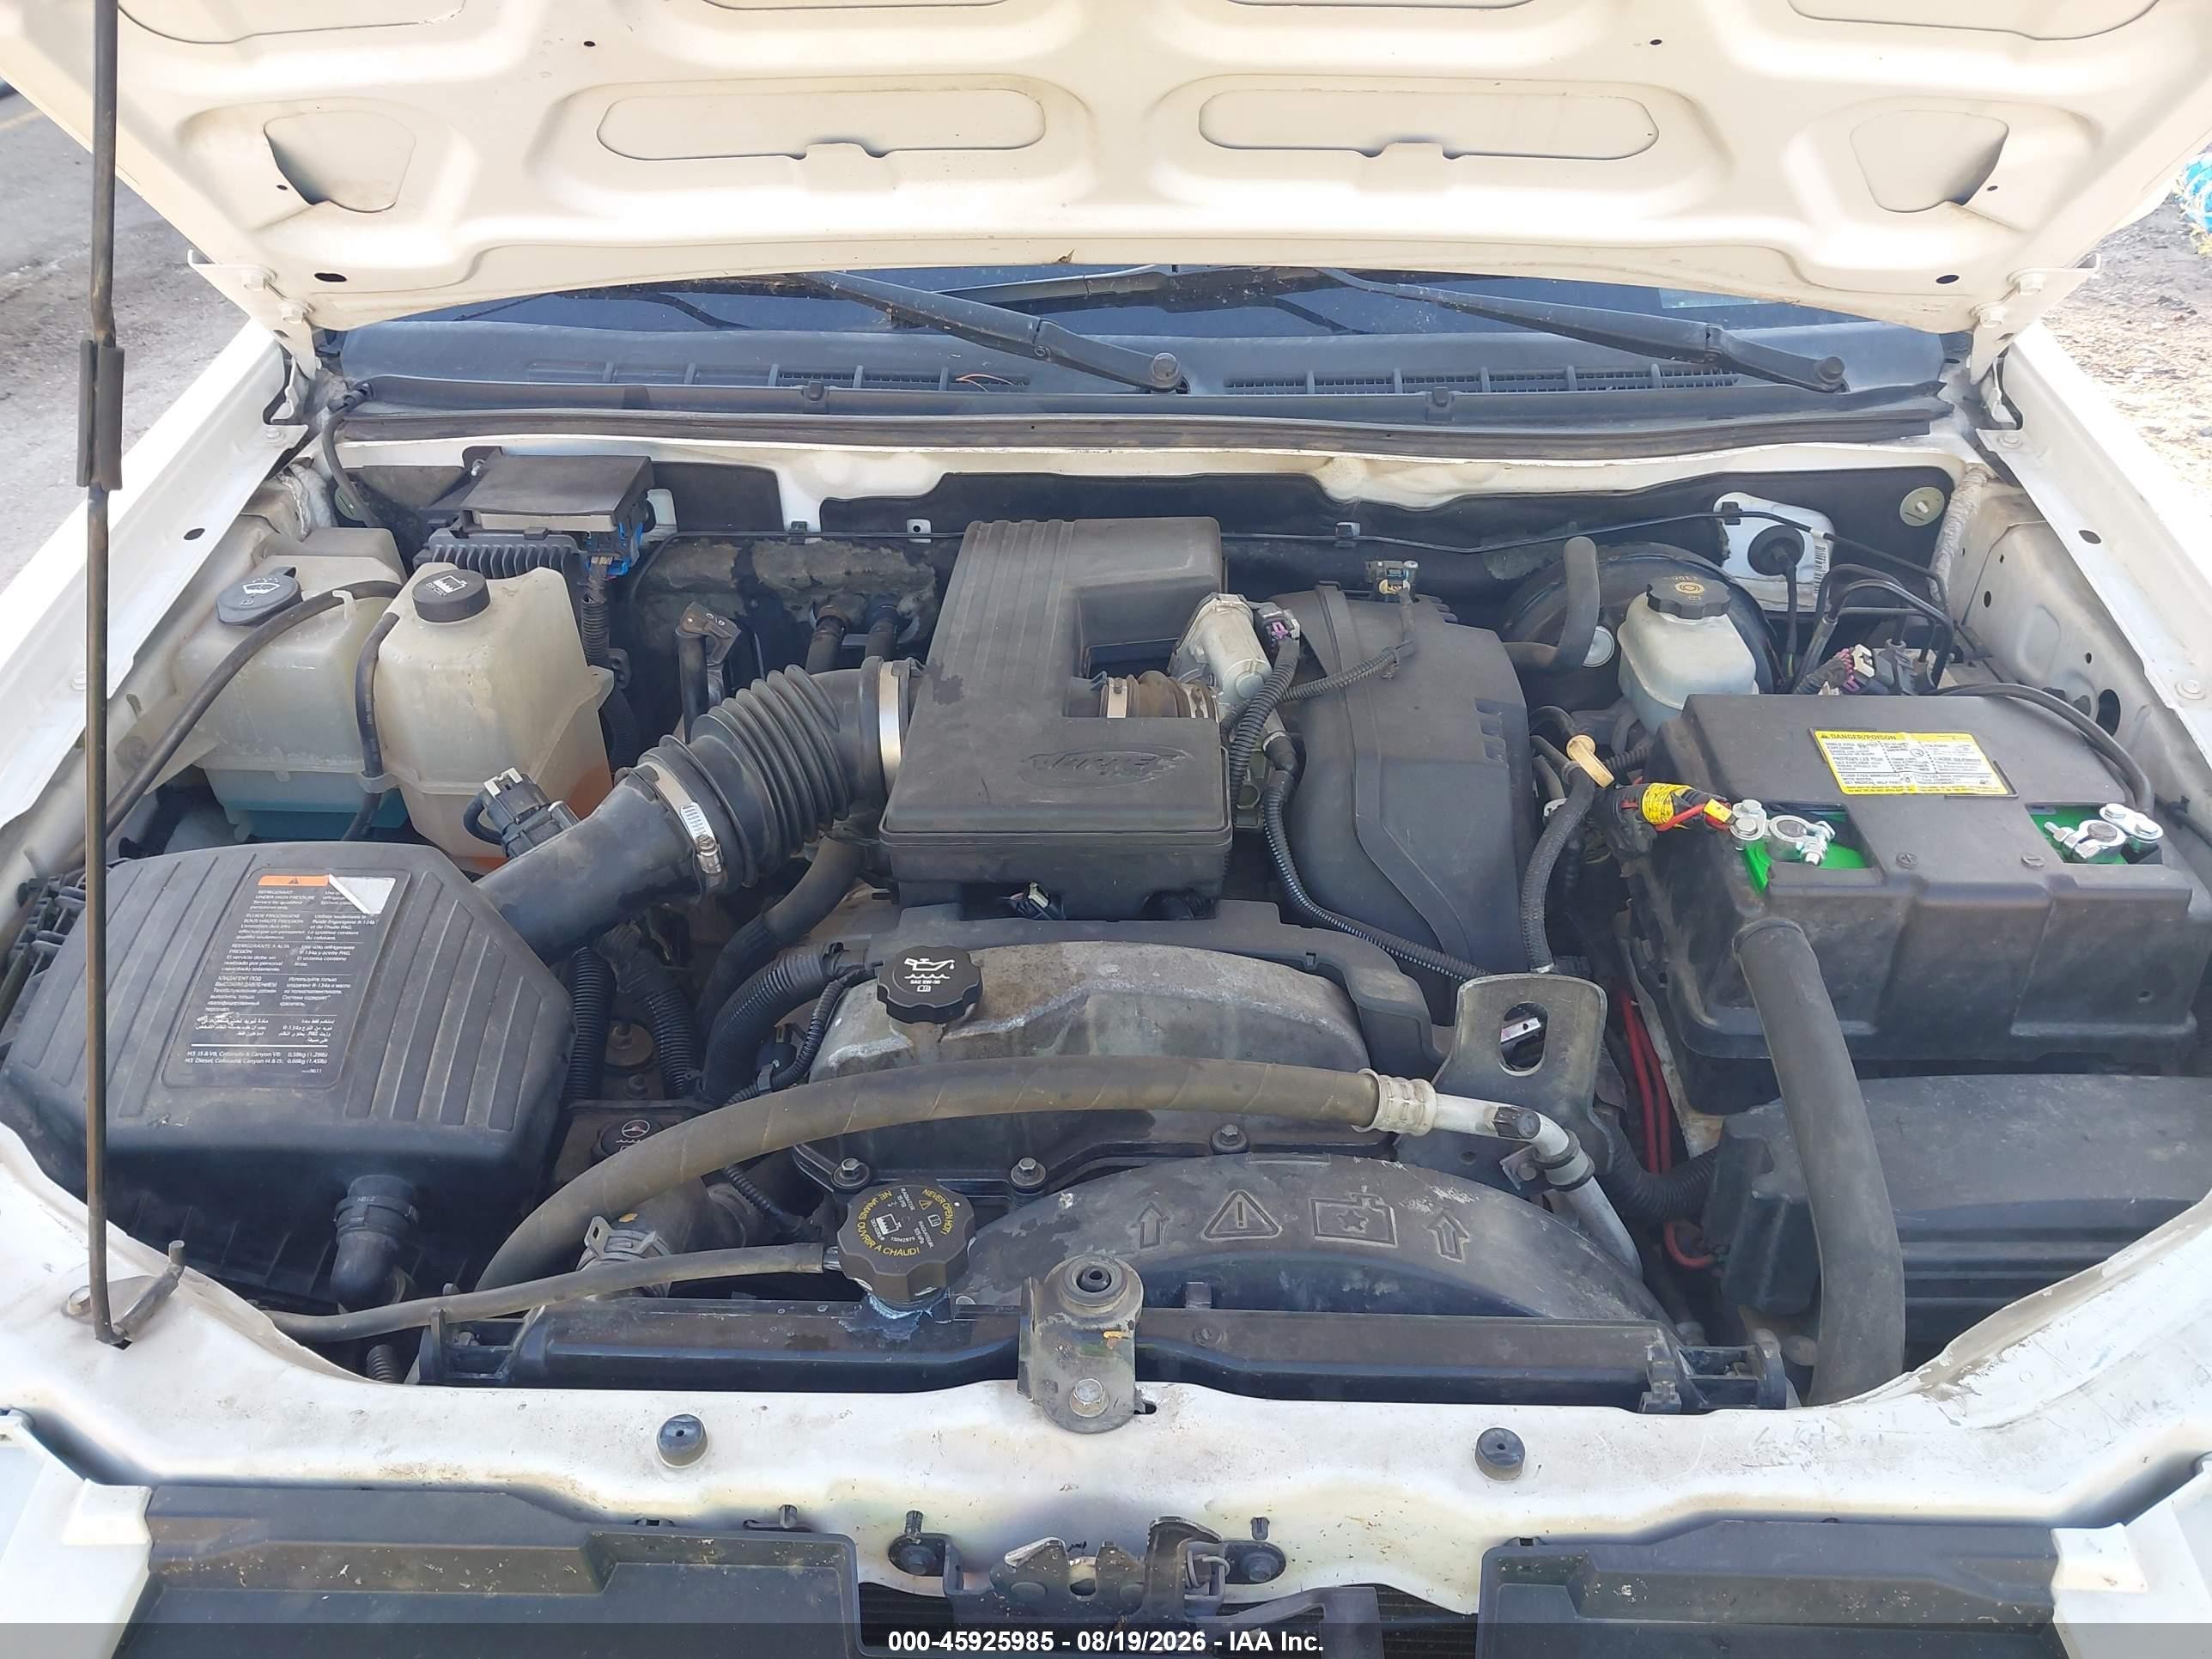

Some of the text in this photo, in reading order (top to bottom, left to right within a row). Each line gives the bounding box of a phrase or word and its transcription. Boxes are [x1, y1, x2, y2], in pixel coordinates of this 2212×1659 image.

[880, 1190, 893, 1201] NE
[900, 1188, 915, 1211] RADIATOR
[922, 1188, 946, 1204] NEVER
[942, 1202, 954, 1223] OPEN
[858, 1197, 879, 1221] JAMAIS
[857, 1221, 877, 1249] OUVRIR
[918, 1221, 934, 1249] RADIATEUR
